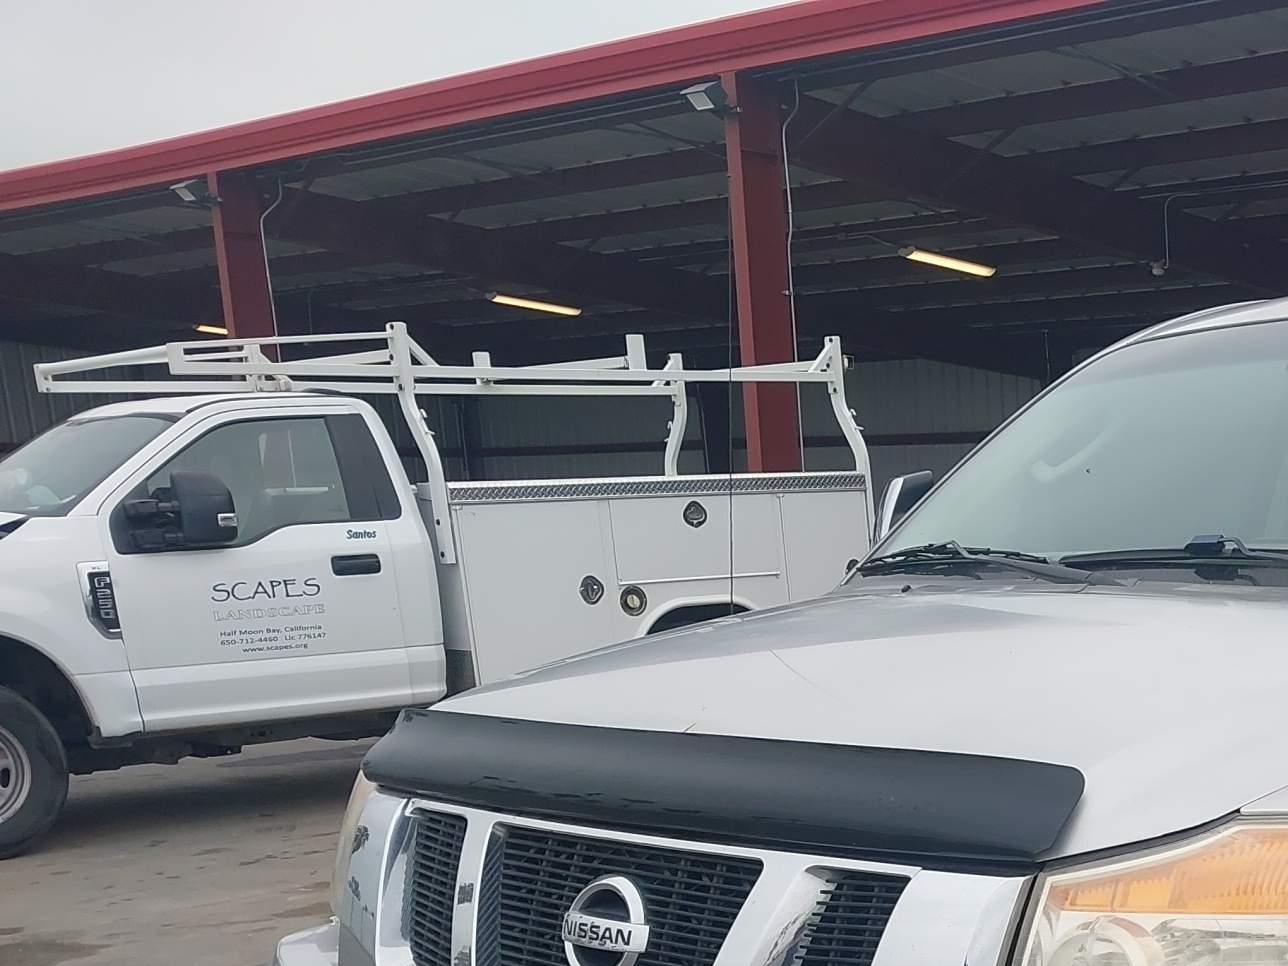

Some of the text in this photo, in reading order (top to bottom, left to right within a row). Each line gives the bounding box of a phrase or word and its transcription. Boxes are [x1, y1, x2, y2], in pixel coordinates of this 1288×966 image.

[346, 529, 377, 540] Santos
[211, 577, 321, 602] SCAPES
[212, 603, 326, 621] LANDSCAPE
[284, 624, 322, 633] California
[242, 643, 308, 653] www.scapes.org
[563, 918, 632, 946] NISSAN
